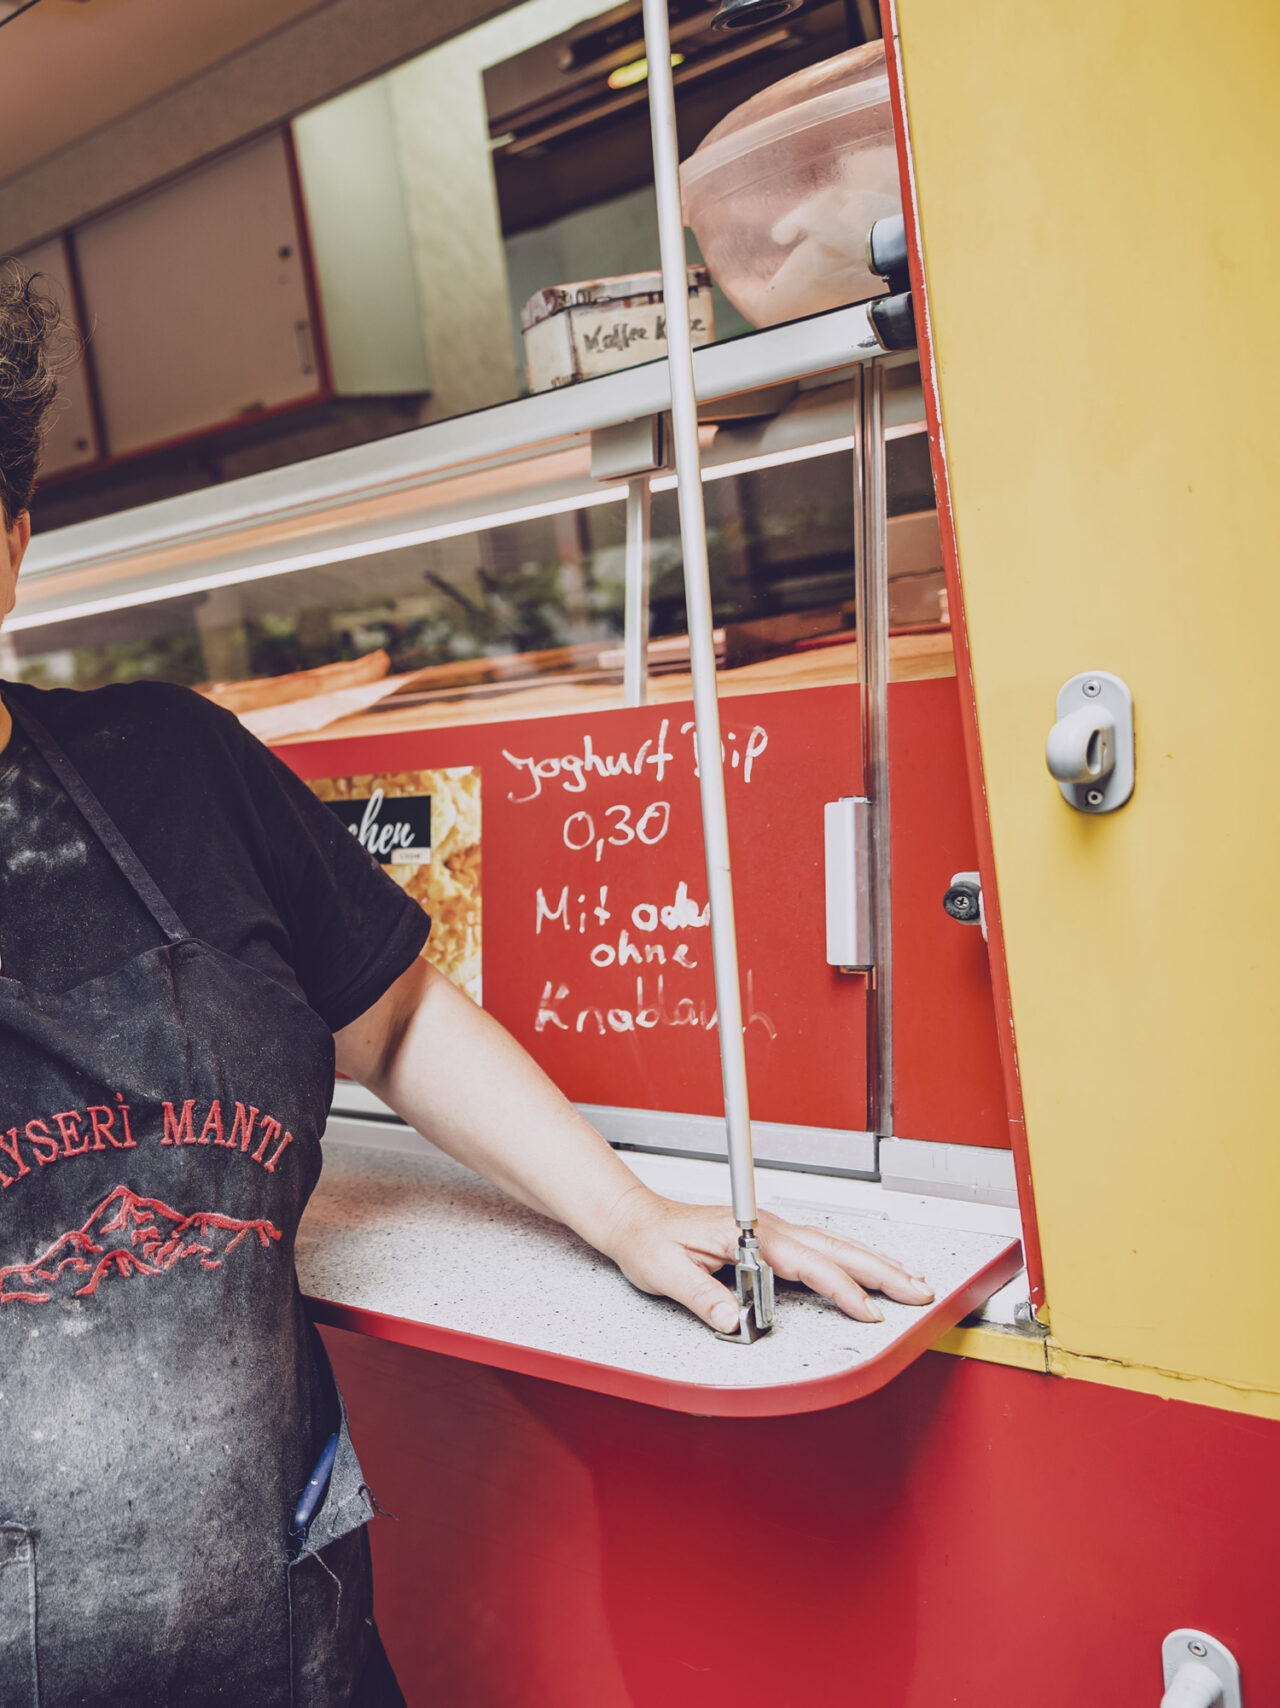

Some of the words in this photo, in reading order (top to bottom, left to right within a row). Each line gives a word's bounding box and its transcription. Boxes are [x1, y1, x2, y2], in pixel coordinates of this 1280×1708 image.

[583, 323, 649, 352] Kaffee
[502, 719, 673, 803] Joghurt
[563, 801, 670, 862] 0,30
[535, 885, 611, 934] Mit
[590, 929, 698, 968] ohne
[534, 968, 778, 1040] Knoblauh
[161, 1099, 293, 1173] MANTI
